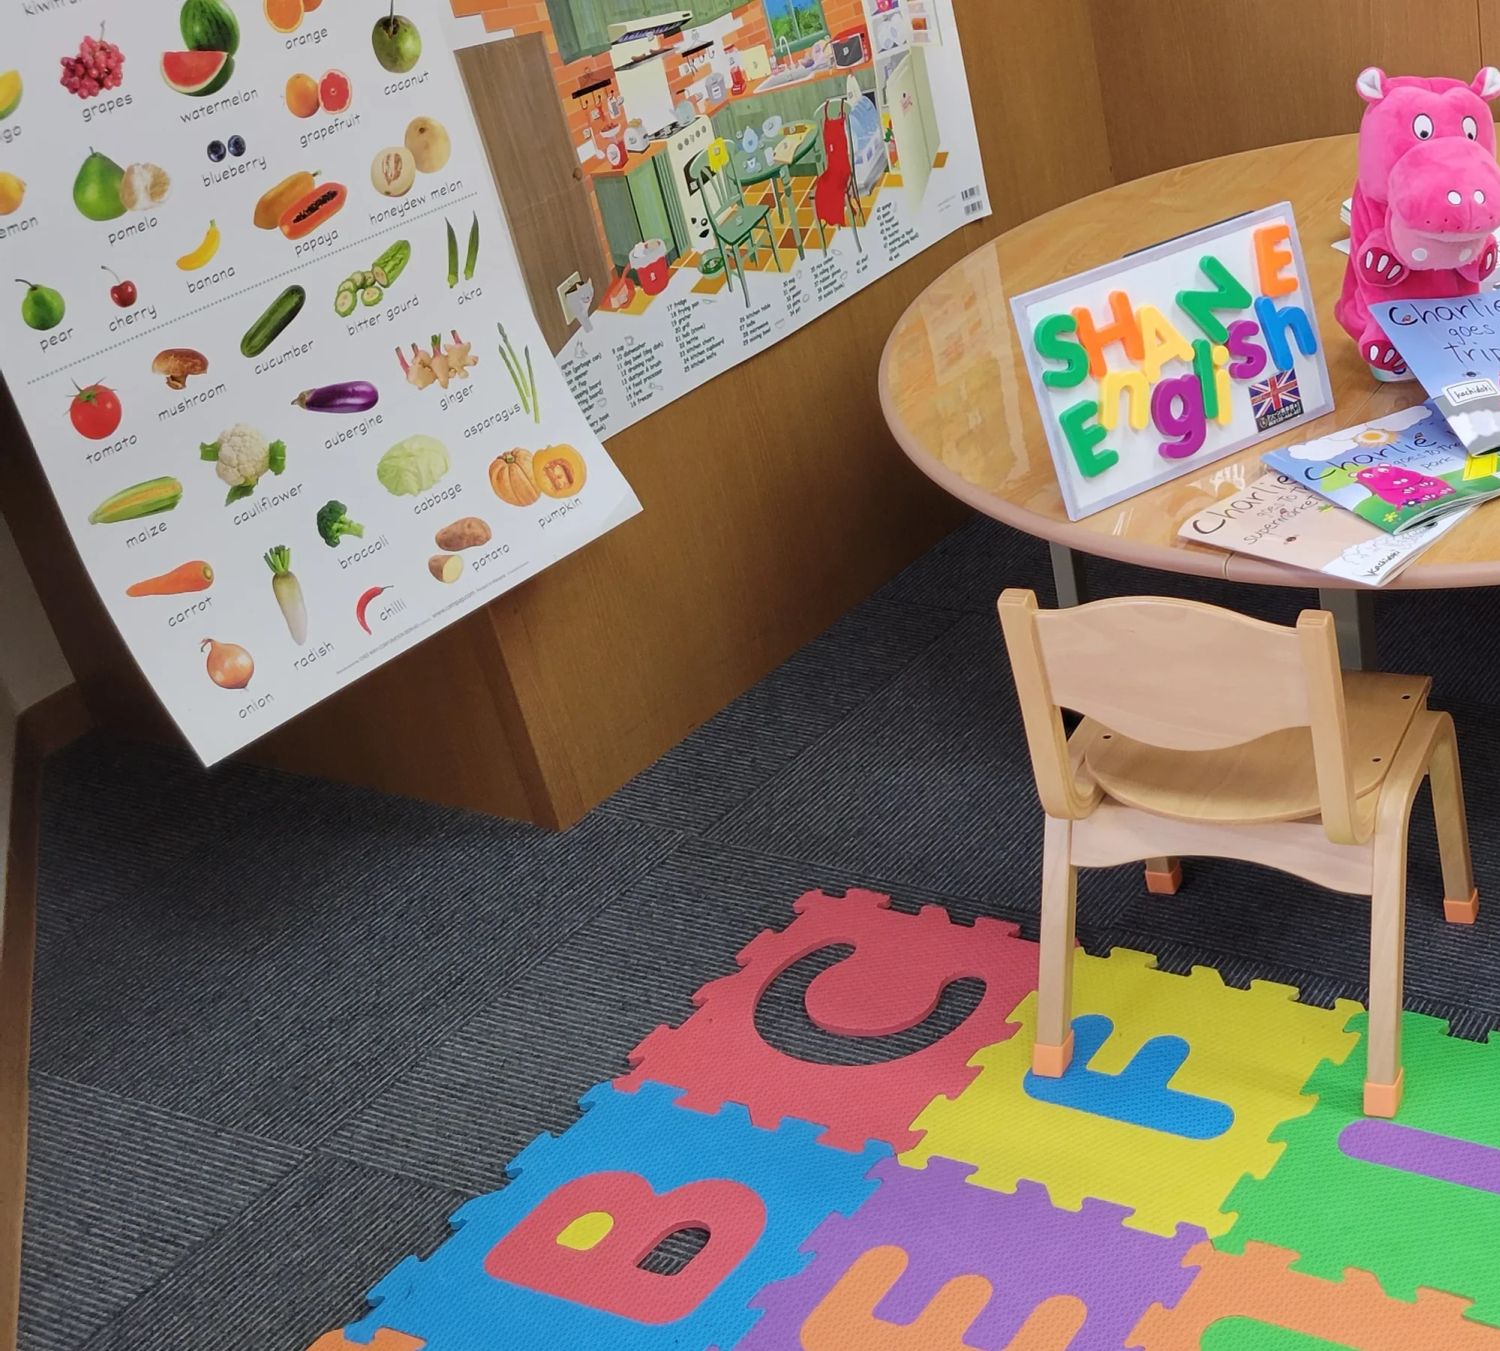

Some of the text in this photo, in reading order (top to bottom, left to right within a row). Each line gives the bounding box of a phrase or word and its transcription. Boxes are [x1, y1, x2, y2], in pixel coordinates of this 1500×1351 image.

[285, 27, 329, 50] orange
[383, 71, 429, 96] coconut
[82, 93, 133, 123] grapes
[180, 86, 257, 123] watermelon
[299, 112, 361, 149] grapefruit
[202, 154, 267, 188] blueberry
[369, 180, 462, 225] honeydew melon
[0, 216, 39, 239] emon
[107, 216, 158, 247] pomelo
[294, 229, 339, 257] papaya
[186, 266, 236, 294] banana
[457, 287, 483, 305] okra
[108, 305, 158, 335] cherry
[347, 296, 420, 337] bitter gourd
[1033, 224, 1299, 388] SHANE
[39, 327, 74, 353] pear
[1448, 324, 1495, 346] goes
[254, 339, 314, 375] cucumber
[158, 383, 225, 421] mushroom
[439, 384, 474, 412] ginger
[1059, 296, 1318, 478] English
[324, 410, 384, 450] aubergine
[463, 403, 521, 439] asparagus
[85, 434, 138, 464] tomato
[1304, 437, 1437, 482] Charlie
[1419, 456, 1455, 471] park
[232, 481, 303, 526] cauliflower
[413, 483, 463, 515] cabbage
[537, 494, 581, 529] pumpkin
[1192, 474, 1297, 535] Charlie
[125, 521, 168, 548] maize
[1243, 494, 1324, 545] supermarket
[337, 533, 389, 570] broccoli
[470, 542, 510, 572] potato
[168, 597, 212, 628] carrot
[379, 600, 408, 622] chilli
[292, 640, 335, 669] radish
[238, 693, 273, 719] onion
[753, 943, 987, 1067] C
[1023, 1014, 1235, 1140] F
[484, 1171, 767, 1326] B
